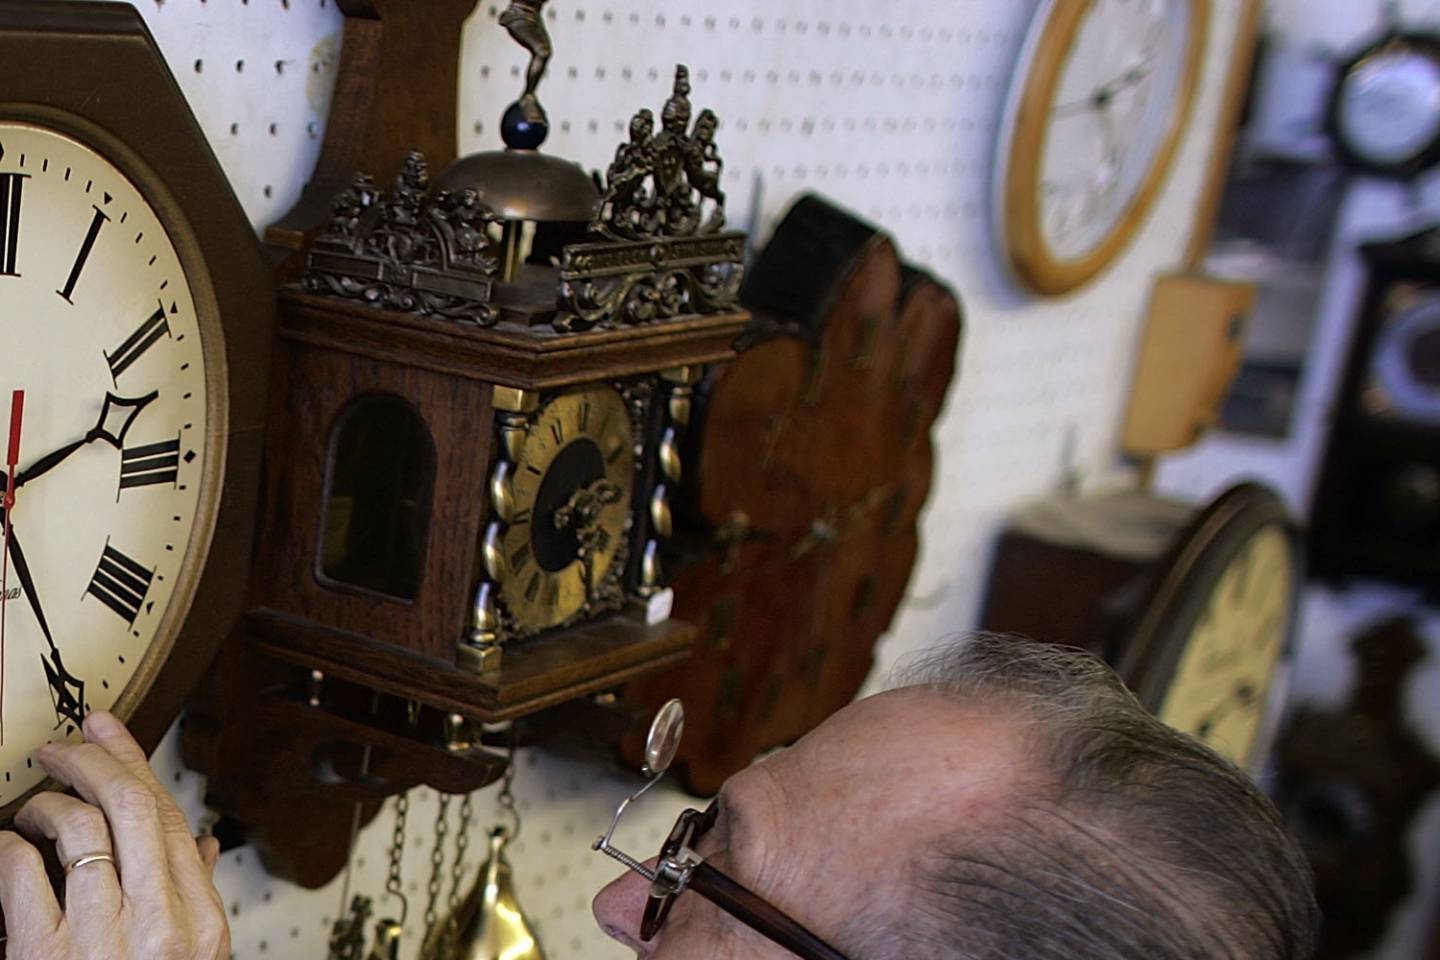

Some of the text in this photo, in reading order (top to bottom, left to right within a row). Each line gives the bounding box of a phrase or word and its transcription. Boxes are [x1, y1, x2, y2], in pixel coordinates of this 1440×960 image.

[56, 204, 111, 306] I
[103, 298, 172, 390] II
[117, 429, 181, 504] III
[81, 534, 158, 633] IIII
